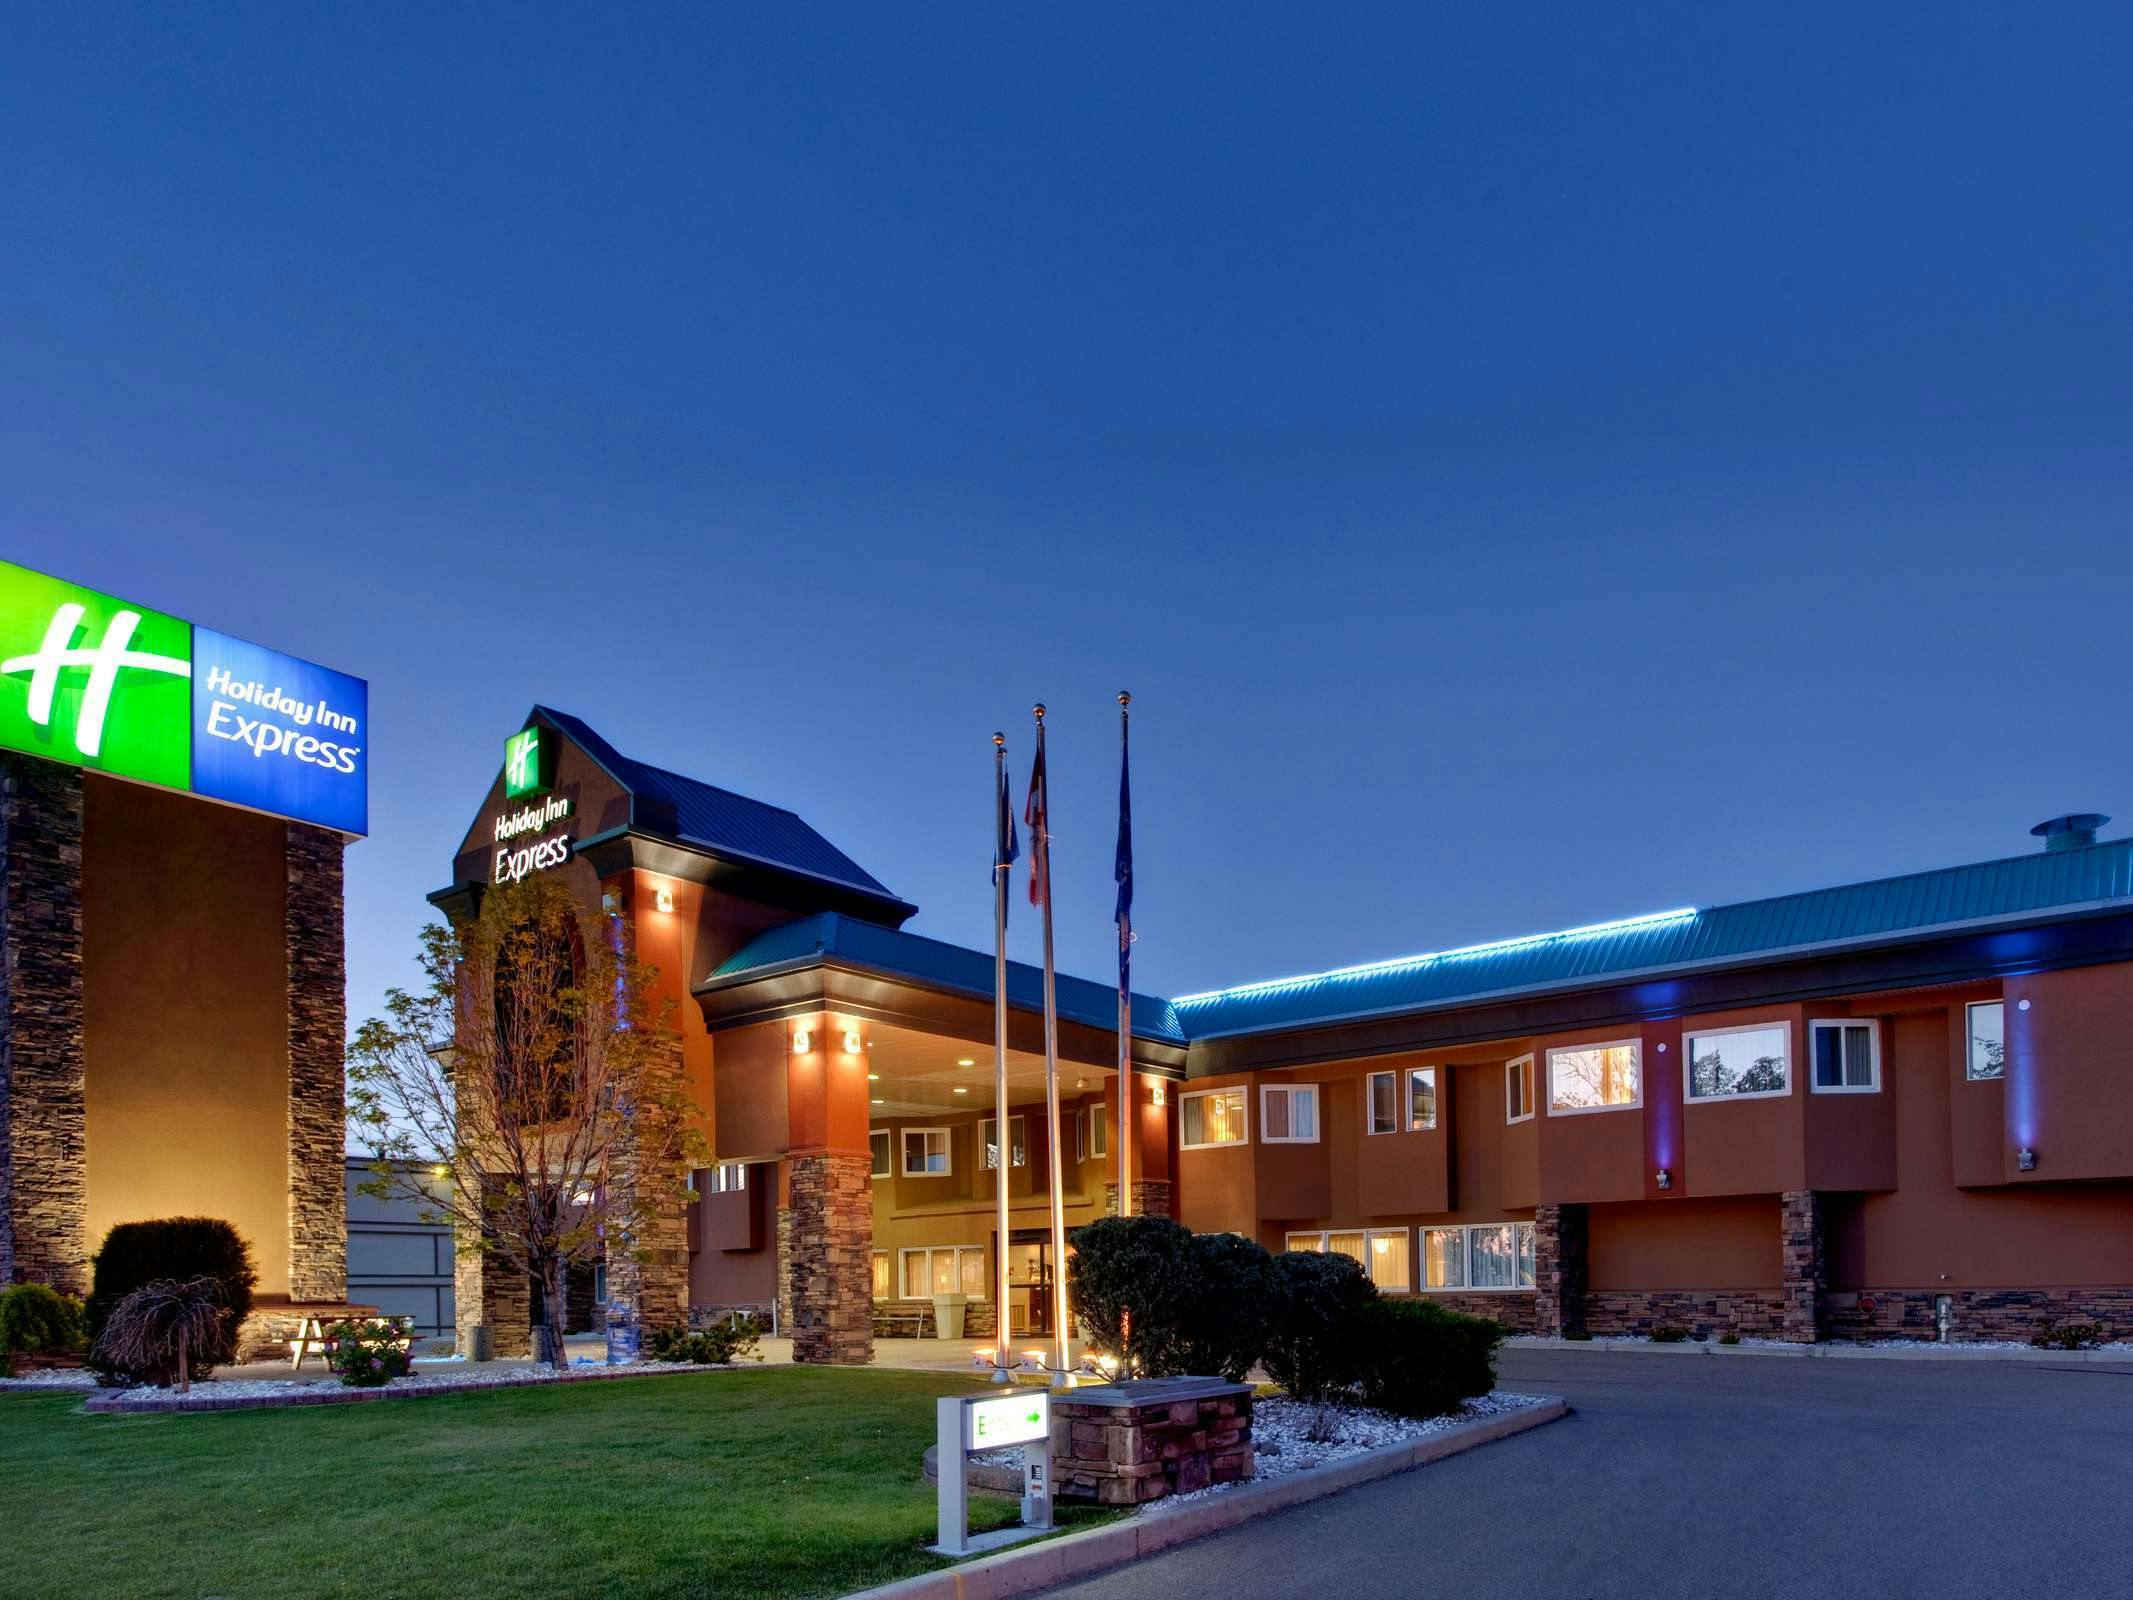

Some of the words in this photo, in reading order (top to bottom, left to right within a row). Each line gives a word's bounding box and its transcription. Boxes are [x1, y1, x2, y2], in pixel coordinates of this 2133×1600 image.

[206, 666, 314, 726] Holiday
[316, 700, 357, 735] Inn
[206, 700, 357, 773] Express
[494, 806, 545, 842] Holiday
[546, 796, 568, 822] Inn
[495, 834, 568, 884] Express
